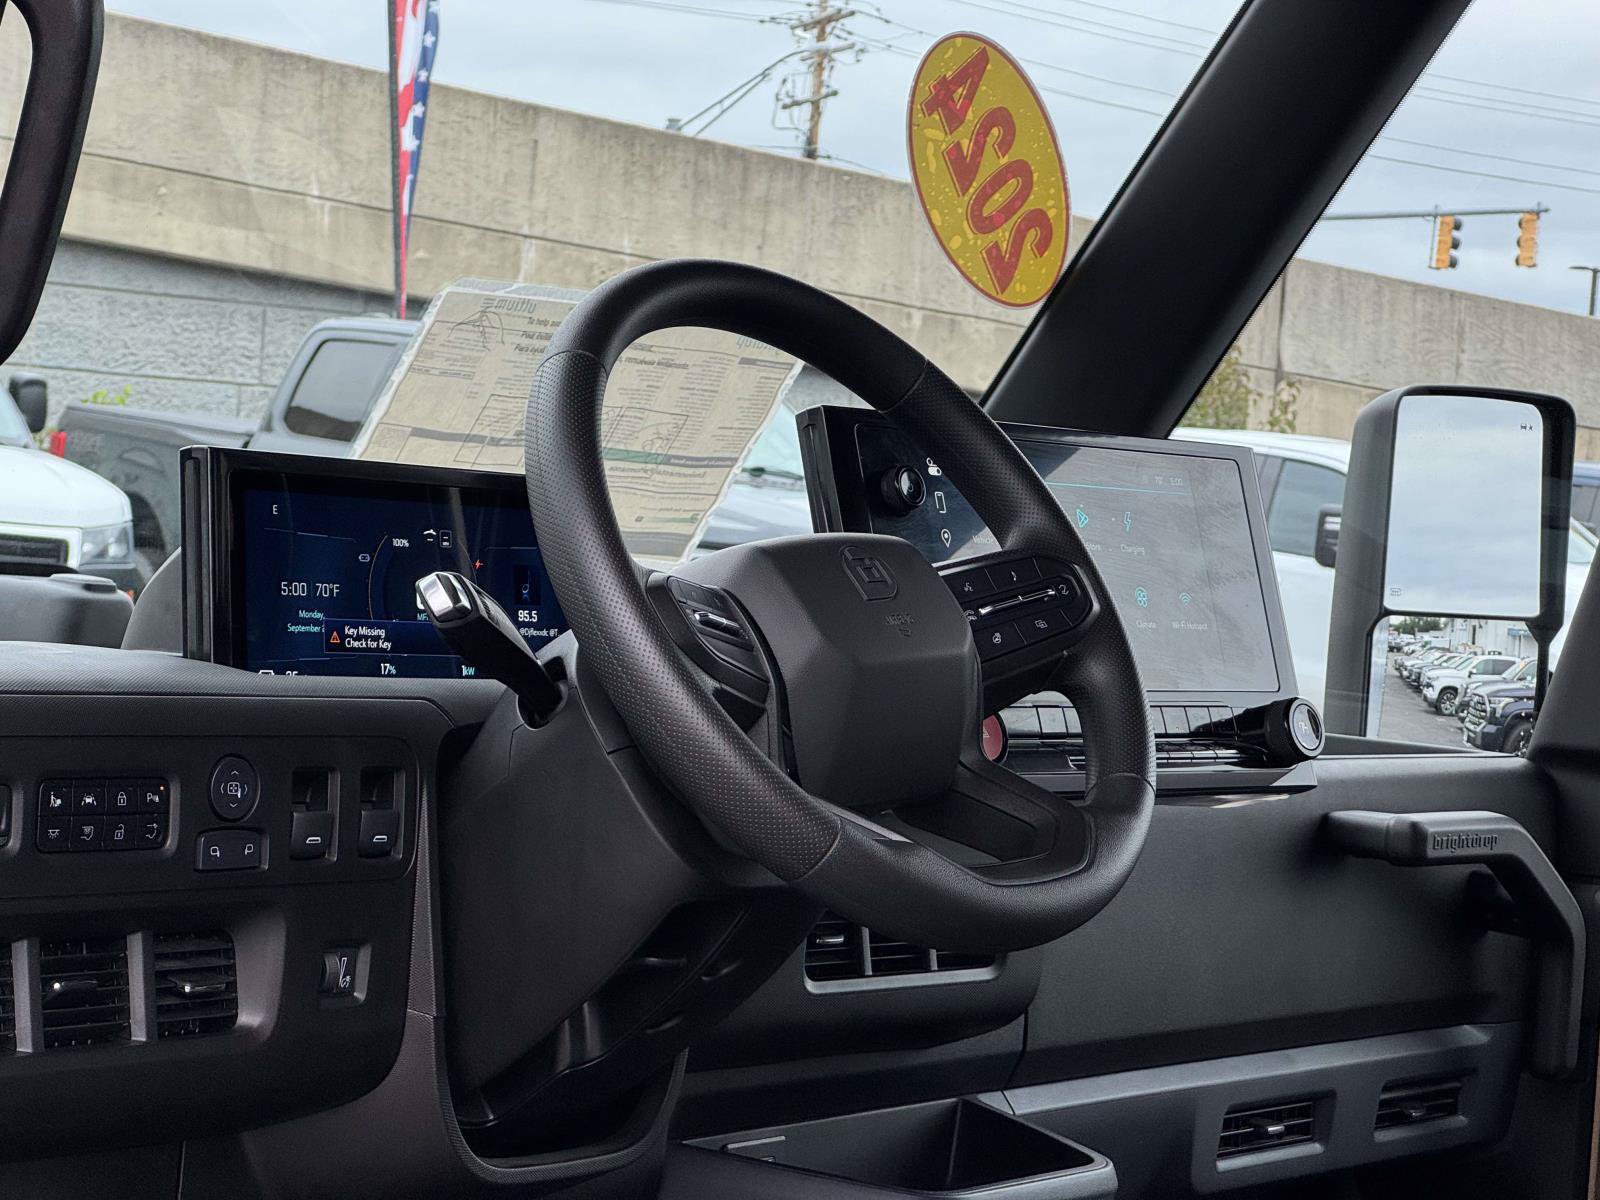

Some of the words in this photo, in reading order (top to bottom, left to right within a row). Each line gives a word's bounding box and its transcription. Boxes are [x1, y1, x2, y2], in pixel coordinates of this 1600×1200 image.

[272, 505, 279, 515] E
[392, 538, 409, 548] 100%
[281, 582, 307, 596] 5:00
[316, 583, 340, 597] 70°F
[298, 610, 326, 621] Monday,
[518, 610, 538, 622] 95.5
[287, 623, 321, 635] September
[344, 626, 357, 637] Key
[358, 626, 386, 638] Missing
[345, 638, 366, 649] Check
[367, 638, 377, 649] for
[378, 639, 392, 651] Key
[380, 663, 396, 675] 17%
[1432, 833, 1498, 853] brightdrop
